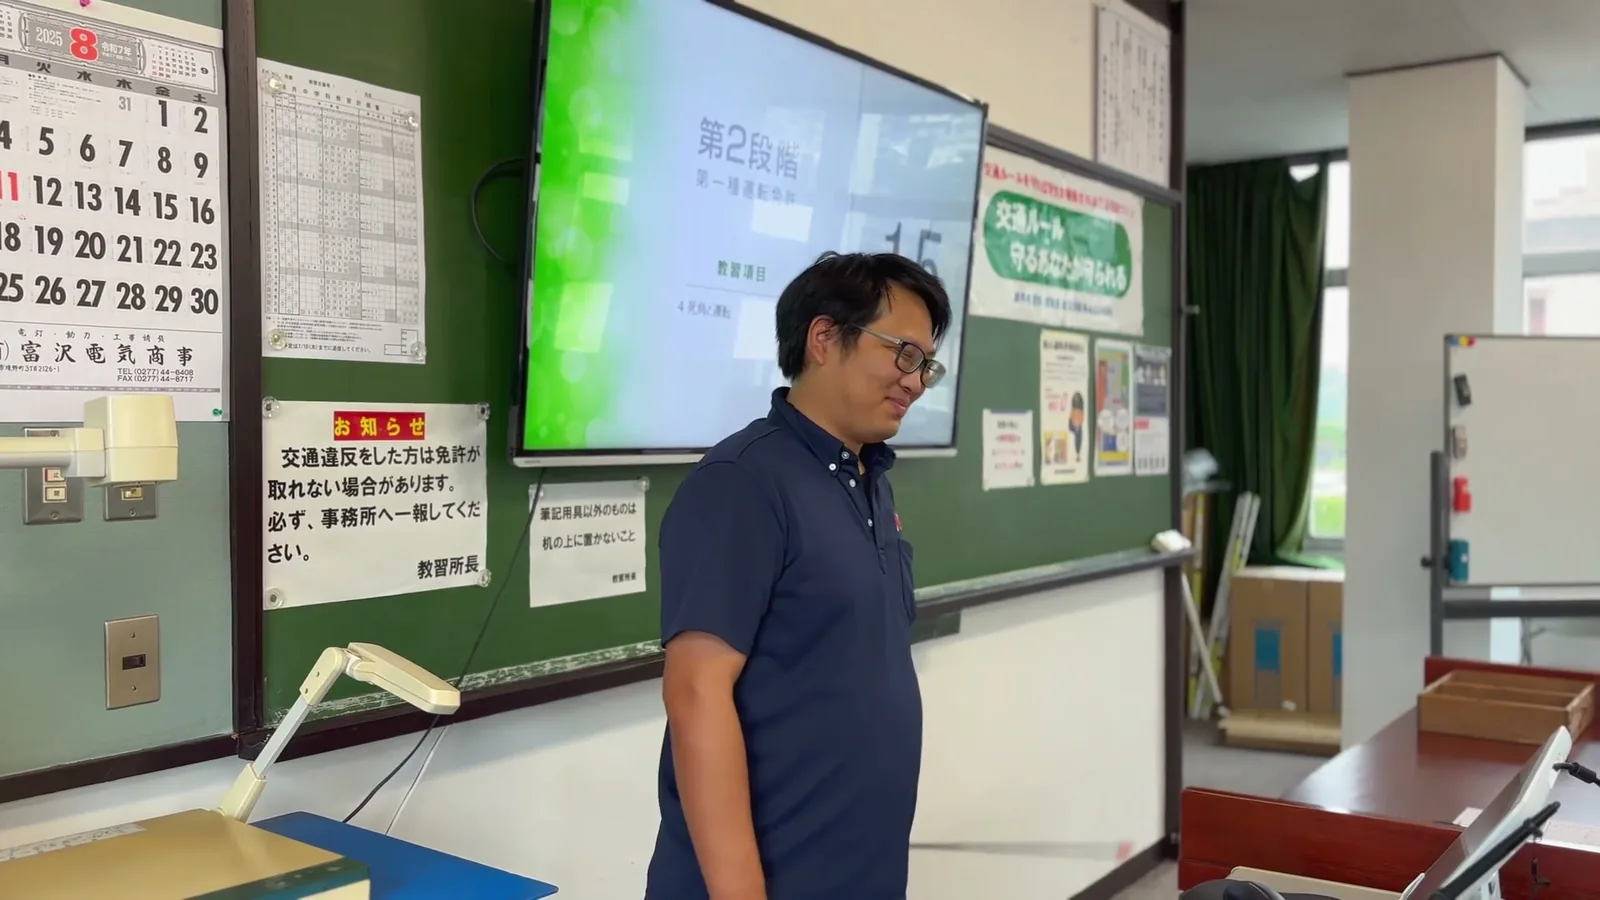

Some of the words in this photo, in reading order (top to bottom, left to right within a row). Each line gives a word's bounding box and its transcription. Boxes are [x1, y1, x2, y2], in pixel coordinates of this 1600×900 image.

[36, 27, 63, 46] 2025
[70, 27, 98, 61] 8
[36, 61, 51, 74] 火
[77, 71, 92, 82] 水
[116, 79, 133, 90] 木
[156, 86, 170, 97] 金
[193, 94, 207, 104] 土
[119, 96, 131, 111] 31
[158, 100, 168, 127] 1
[194, 106, 208, 133] 2
[0, 120, 12, 150] 4
[38, 126, 54, 156] 5
[79, 134, 96, 162] 6
[118, 139, 133, 167] 7
[157, 146, 172, 174] 8
[194, 152, 209, 178] 9
[698, 116, 799, 180] 第2段階
[0, 170, 19, 201] 1
[33, 175, 62, 206] 12
[74, 181, 102, 211] 13
[114, 186, 141, 216] 14
[153, 191, 178, 220] 15
[189, 196, 215, 224] 16
[995, 198, 1065, 241] 交通ルール
[0, 221, 21, 251] 8
[35, 225, 63, 255] 19
[75, 230, 106, 260] 20
[117, 235, 143, 263] 21
[154, 238, 182, 267] 22
[190, 242, 217, 270] 23
[717, 260, 766, 282] 教習項目
[0, 272, 24, 302] 25
[35, 275, 66, 305] 26
[76, 279, 106, 307] 27
[116, 282, 146, 310] 28
[155, 285, 182, 313] 29
[190, 288, 219, 315] 30
[0, 339, 193, 367] )富沢電気商事
[334, 416, 425, 437] お知らせ
[281, 445, 480, 468] 交通違反をした方は免許が
[268, 474, 454, 500] 取れない場合があります。
[268, 501, 481, 532] 必ず、事務所へ一報してくだ
[540, 502, 636, 521] 筆記用具以外のものは
[267, 543, 309, 563] さい。
[542, 530, 636, 550] 机の上に置かないこと
[417, 555, 479, 579] 教習所長
